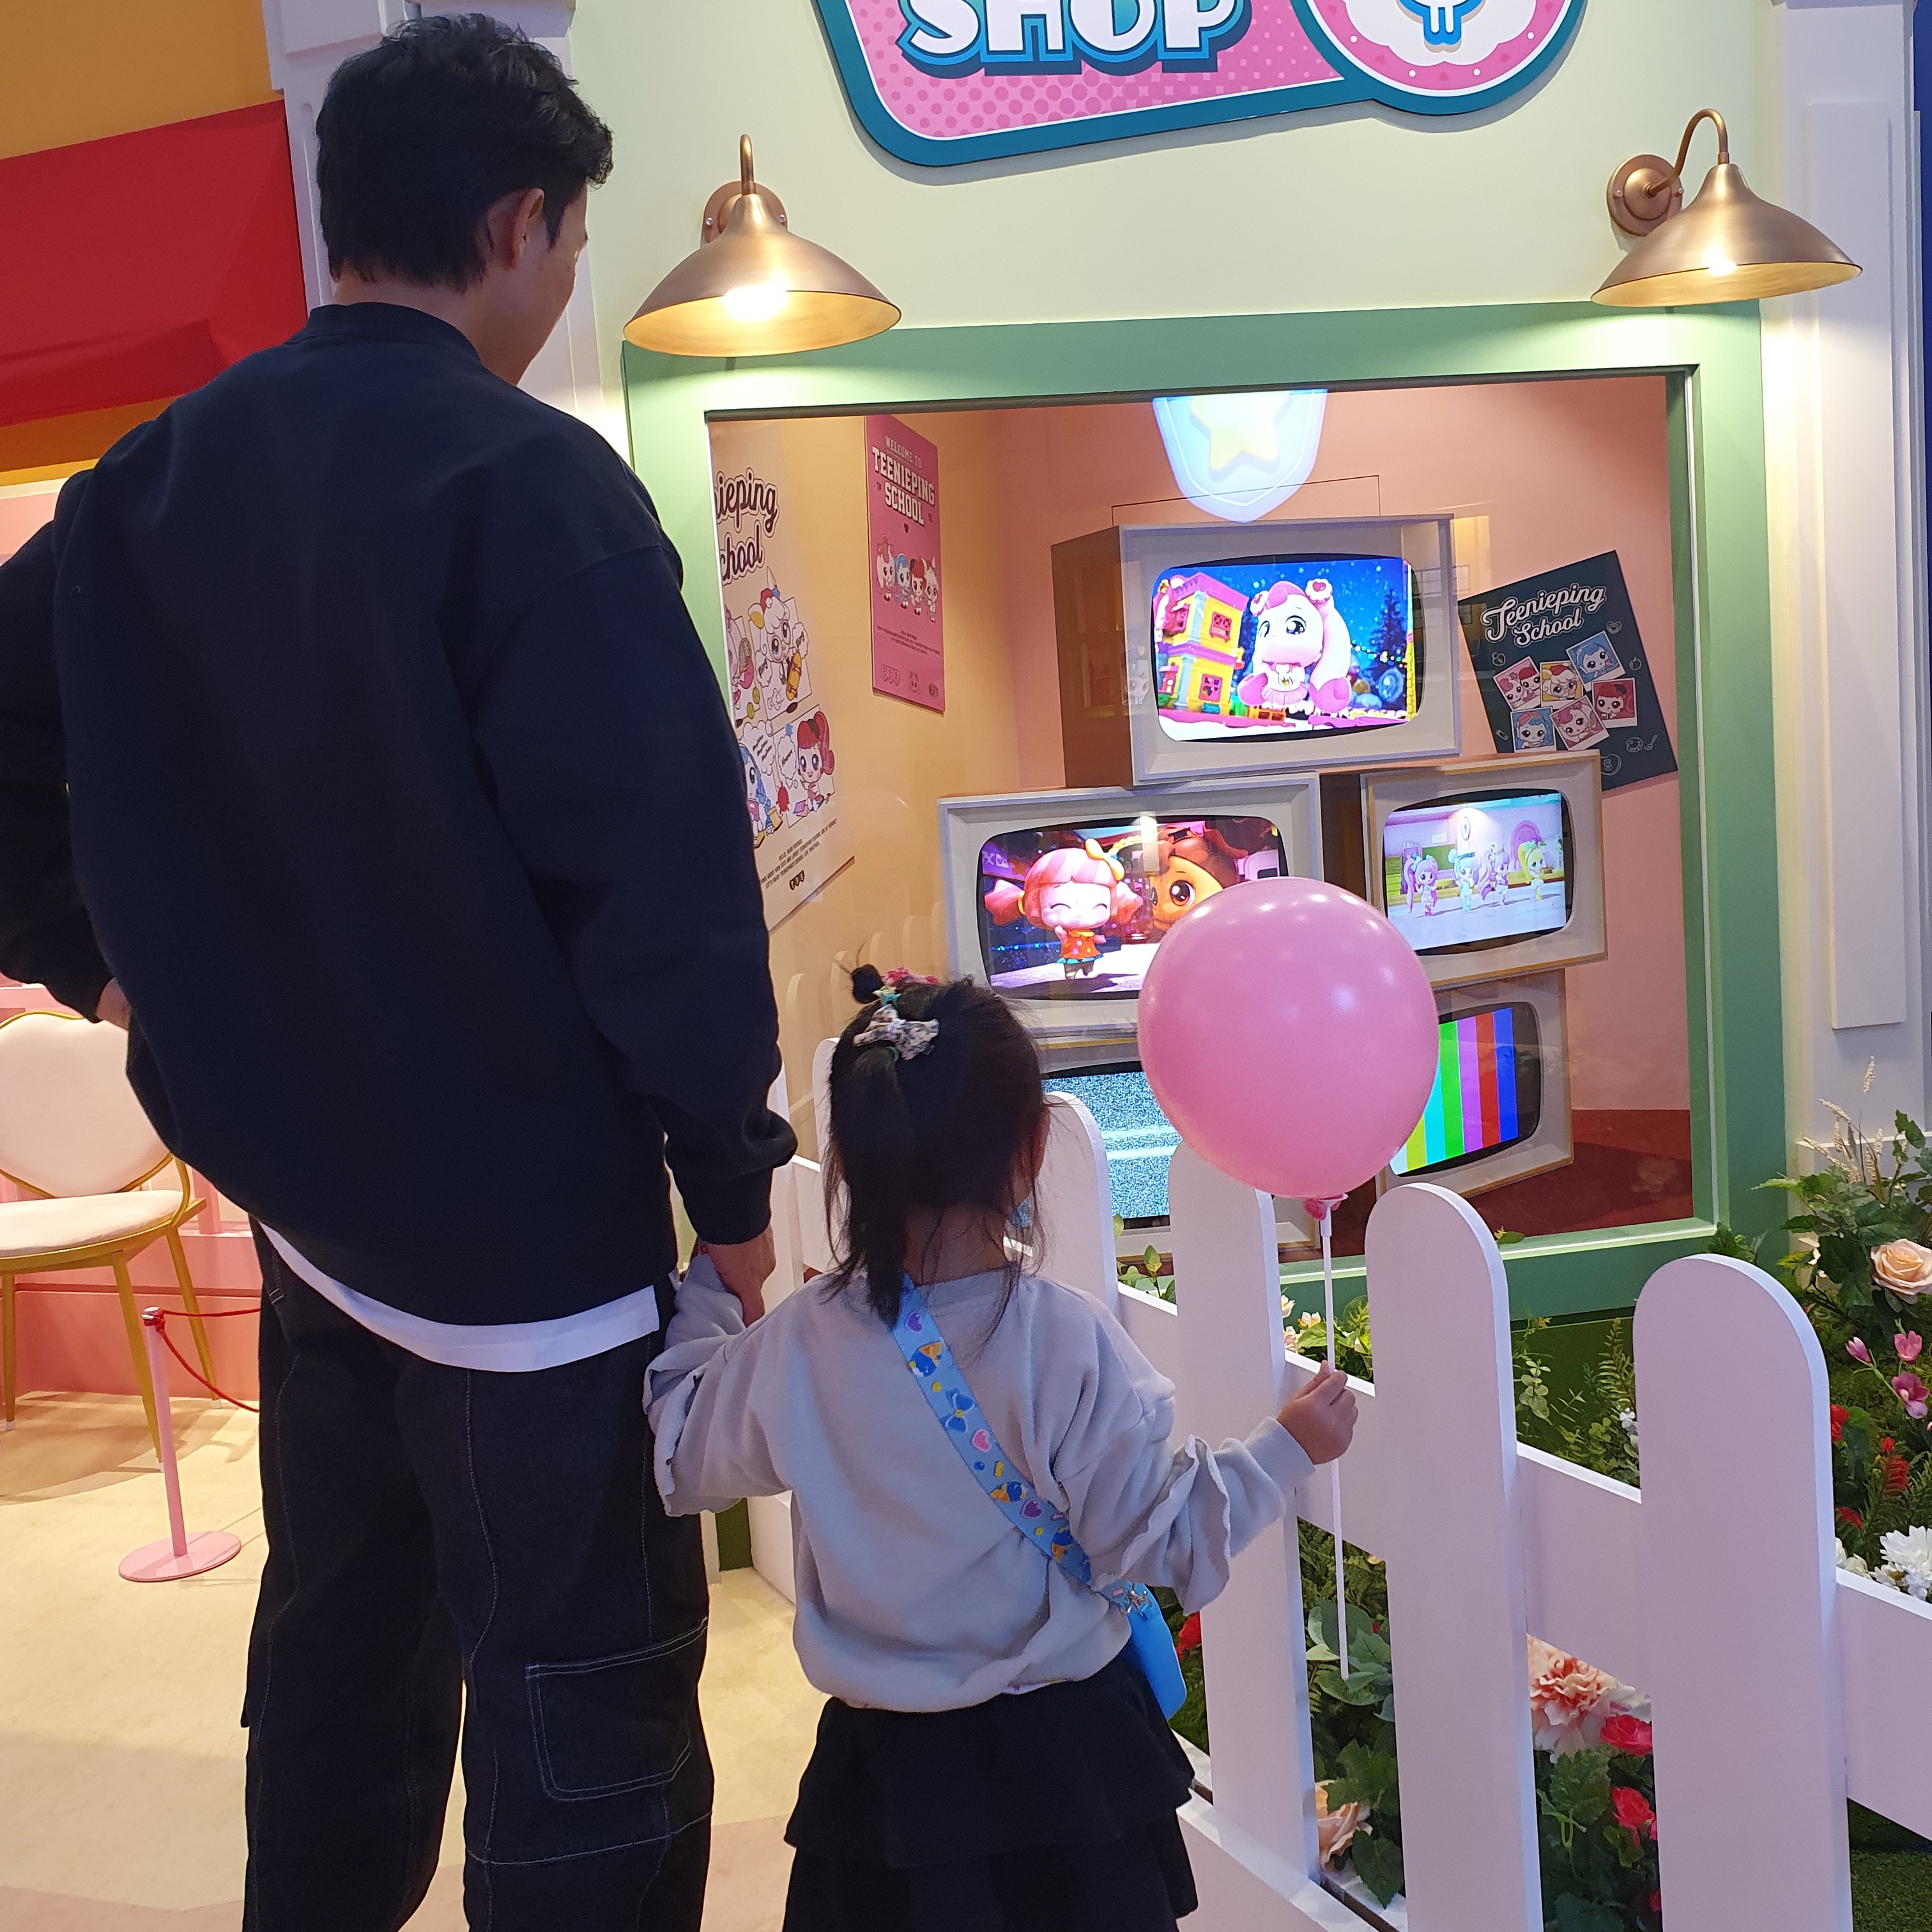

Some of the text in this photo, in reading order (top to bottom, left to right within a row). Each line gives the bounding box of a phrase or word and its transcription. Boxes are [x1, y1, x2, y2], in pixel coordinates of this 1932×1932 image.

[901, 0, 1243, 66] SHOP
[871, 446, 935, 507] TEENIEPING
[885, 436, 922, 468] WELCOME TO
[884, 480, 924, 526] SCHOOL
[1482, 583, 1606, 641] Teenieping
[1512, 607, 1583, 647] School
